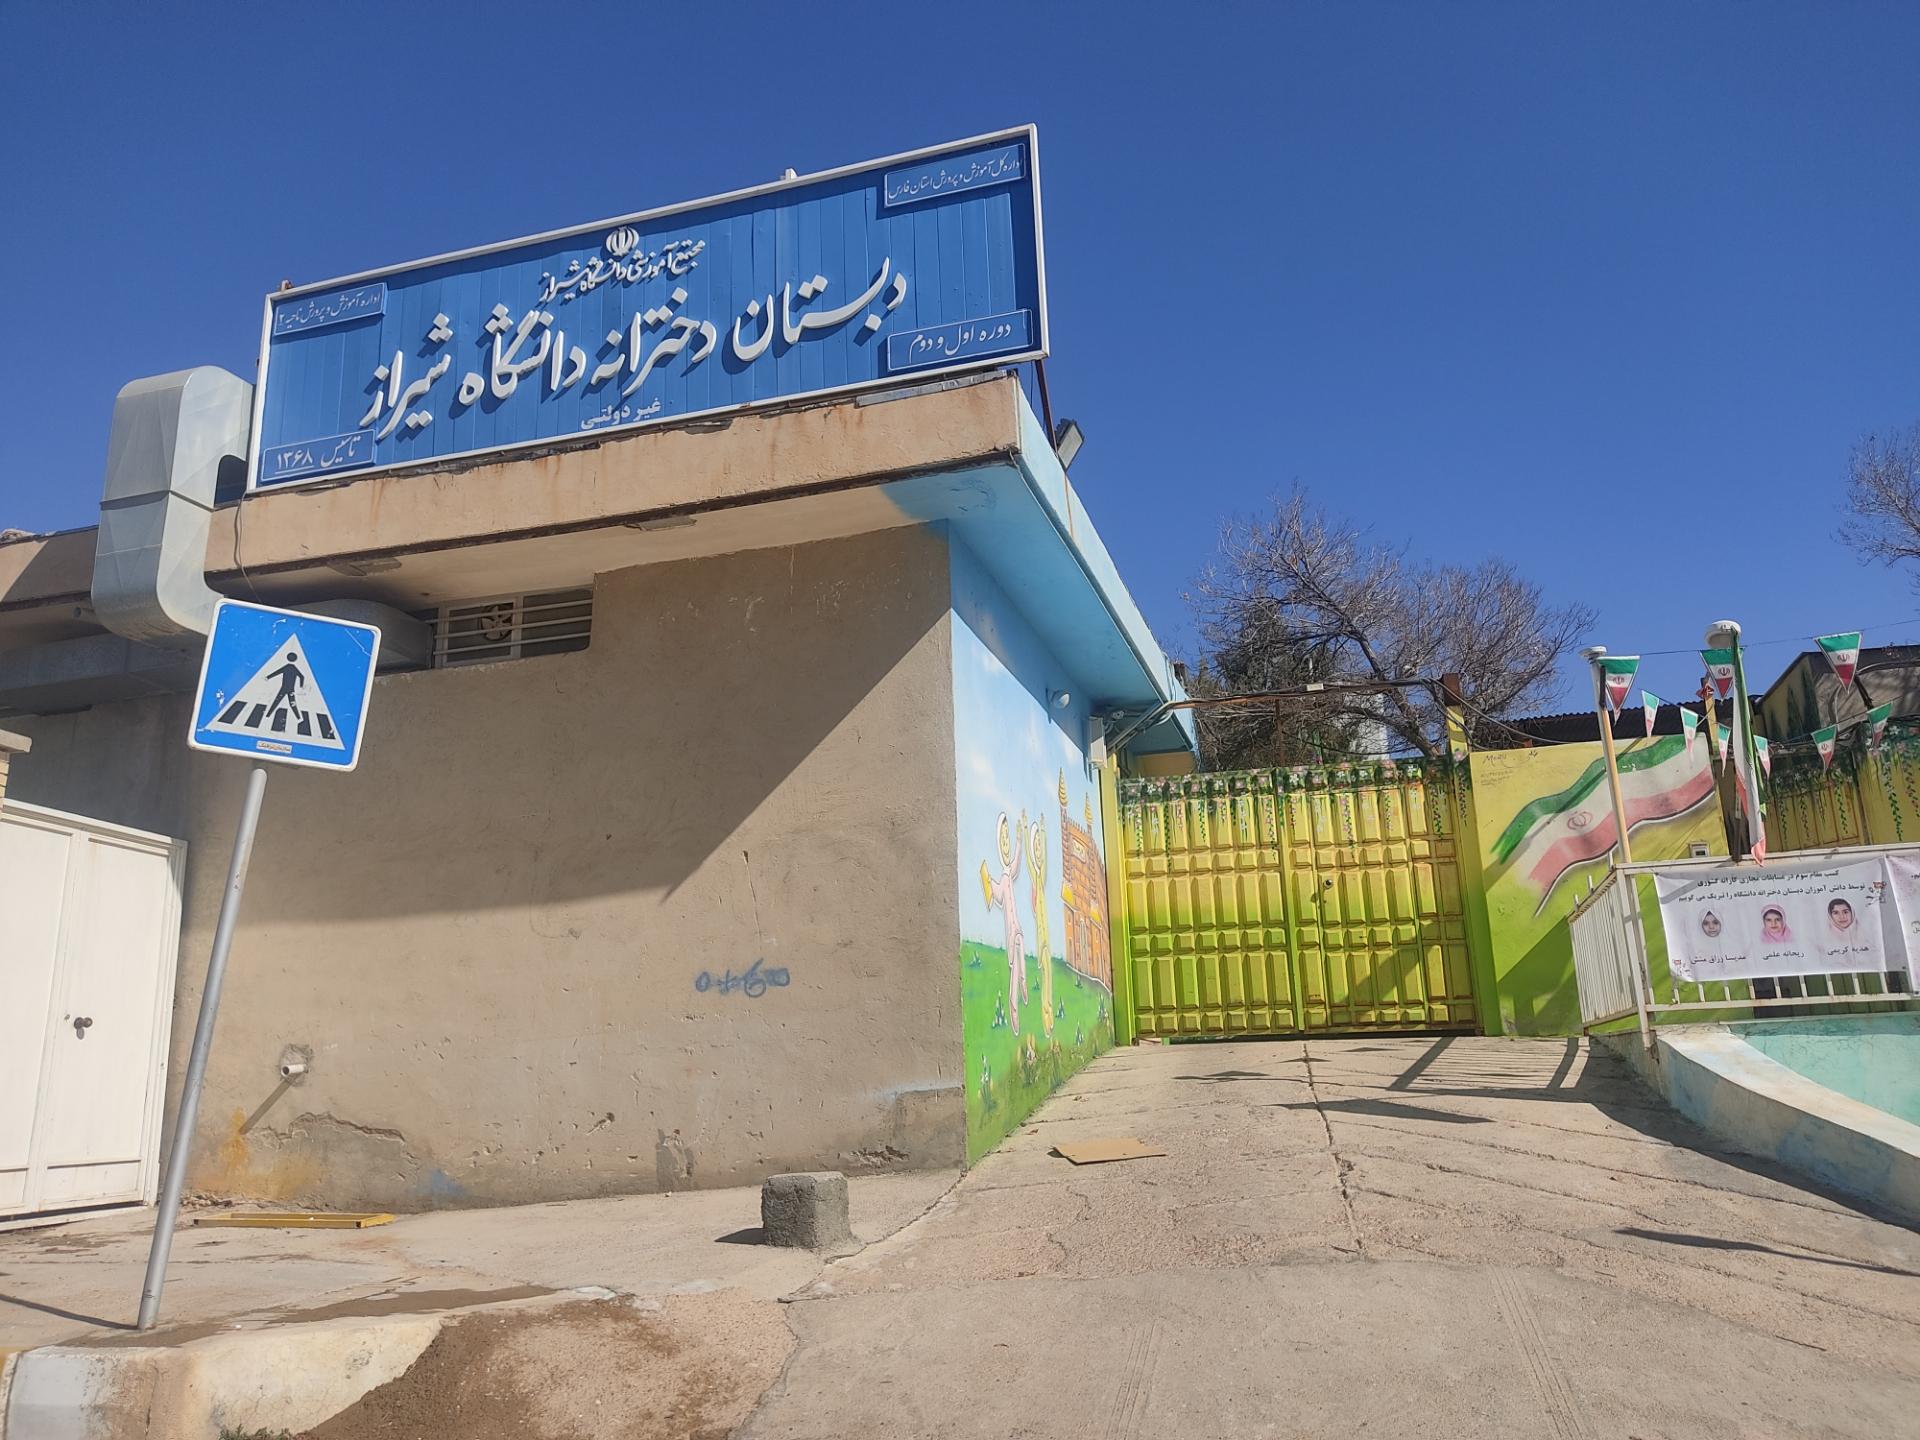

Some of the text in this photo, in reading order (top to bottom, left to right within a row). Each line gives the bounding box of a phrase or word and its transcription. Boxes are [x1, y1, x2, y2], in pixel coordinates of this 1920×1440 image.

[963, 159, 995, 183] آموزش
[991, 151, 1009, 177] کل
[888, 180, 910, 199] فارس
[909, 175, 933, 195] استان
[932, 169, 959, 189] پرورش
[539, 239, 706, 303] مجتمع آموزشی دانشگاه شیراز
[300, 300, 326, 323] پرورش
[330, 291, 364, 317] آموزش
[360, 292, 381, 307] اداره
[285, 307, 303, 329] ناحیه
[359, 256, 907, 441] دبستان دخترانه دانشگاه شیراز
[909, 323, 1012, 364] دوره اول و دوم
[581, 397, 661, 430] غیر دولتی
